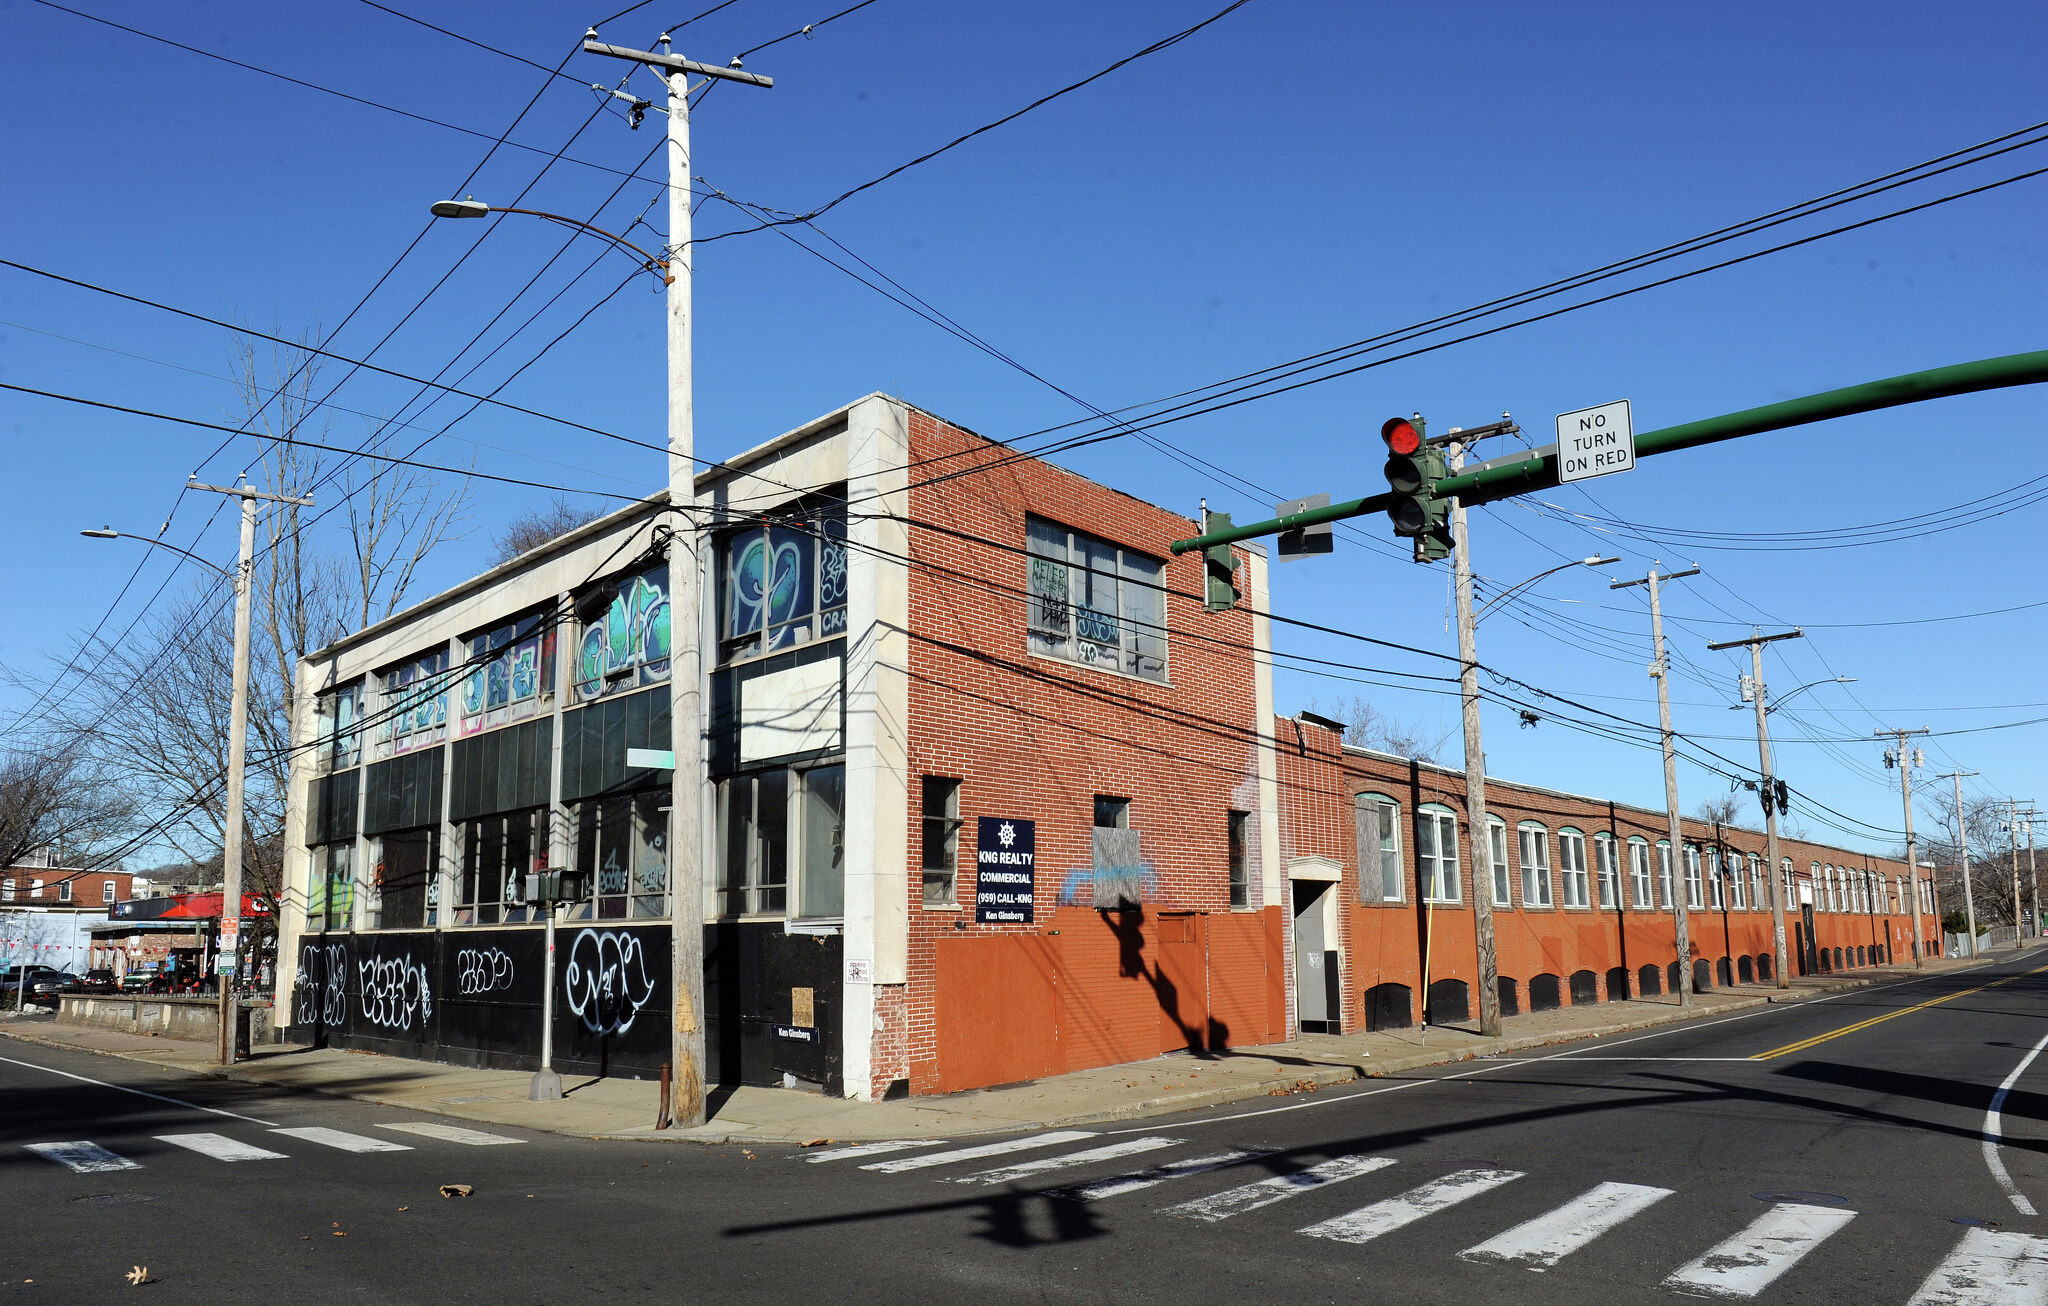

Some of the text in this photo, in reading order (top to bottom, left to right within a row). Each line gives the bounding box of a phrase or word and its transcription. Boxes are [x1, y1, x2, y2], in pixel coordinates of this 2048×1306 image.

[1579, 414, 1606, 431] NO
[1573, 431, 1616, 451] TURN
[1566, 449, 1627, 473] ON RED
[979, 850, 1033, 865] KNG REALTY
[980, 872, 1031, 884] COMMERCIAL
[977, 892, 1033, 905] (959) CALL-KNG
[985, 911, 1024, 921] Ken Ginsberg
[778, 1028, 811, 1041] Ken Ginsberg
